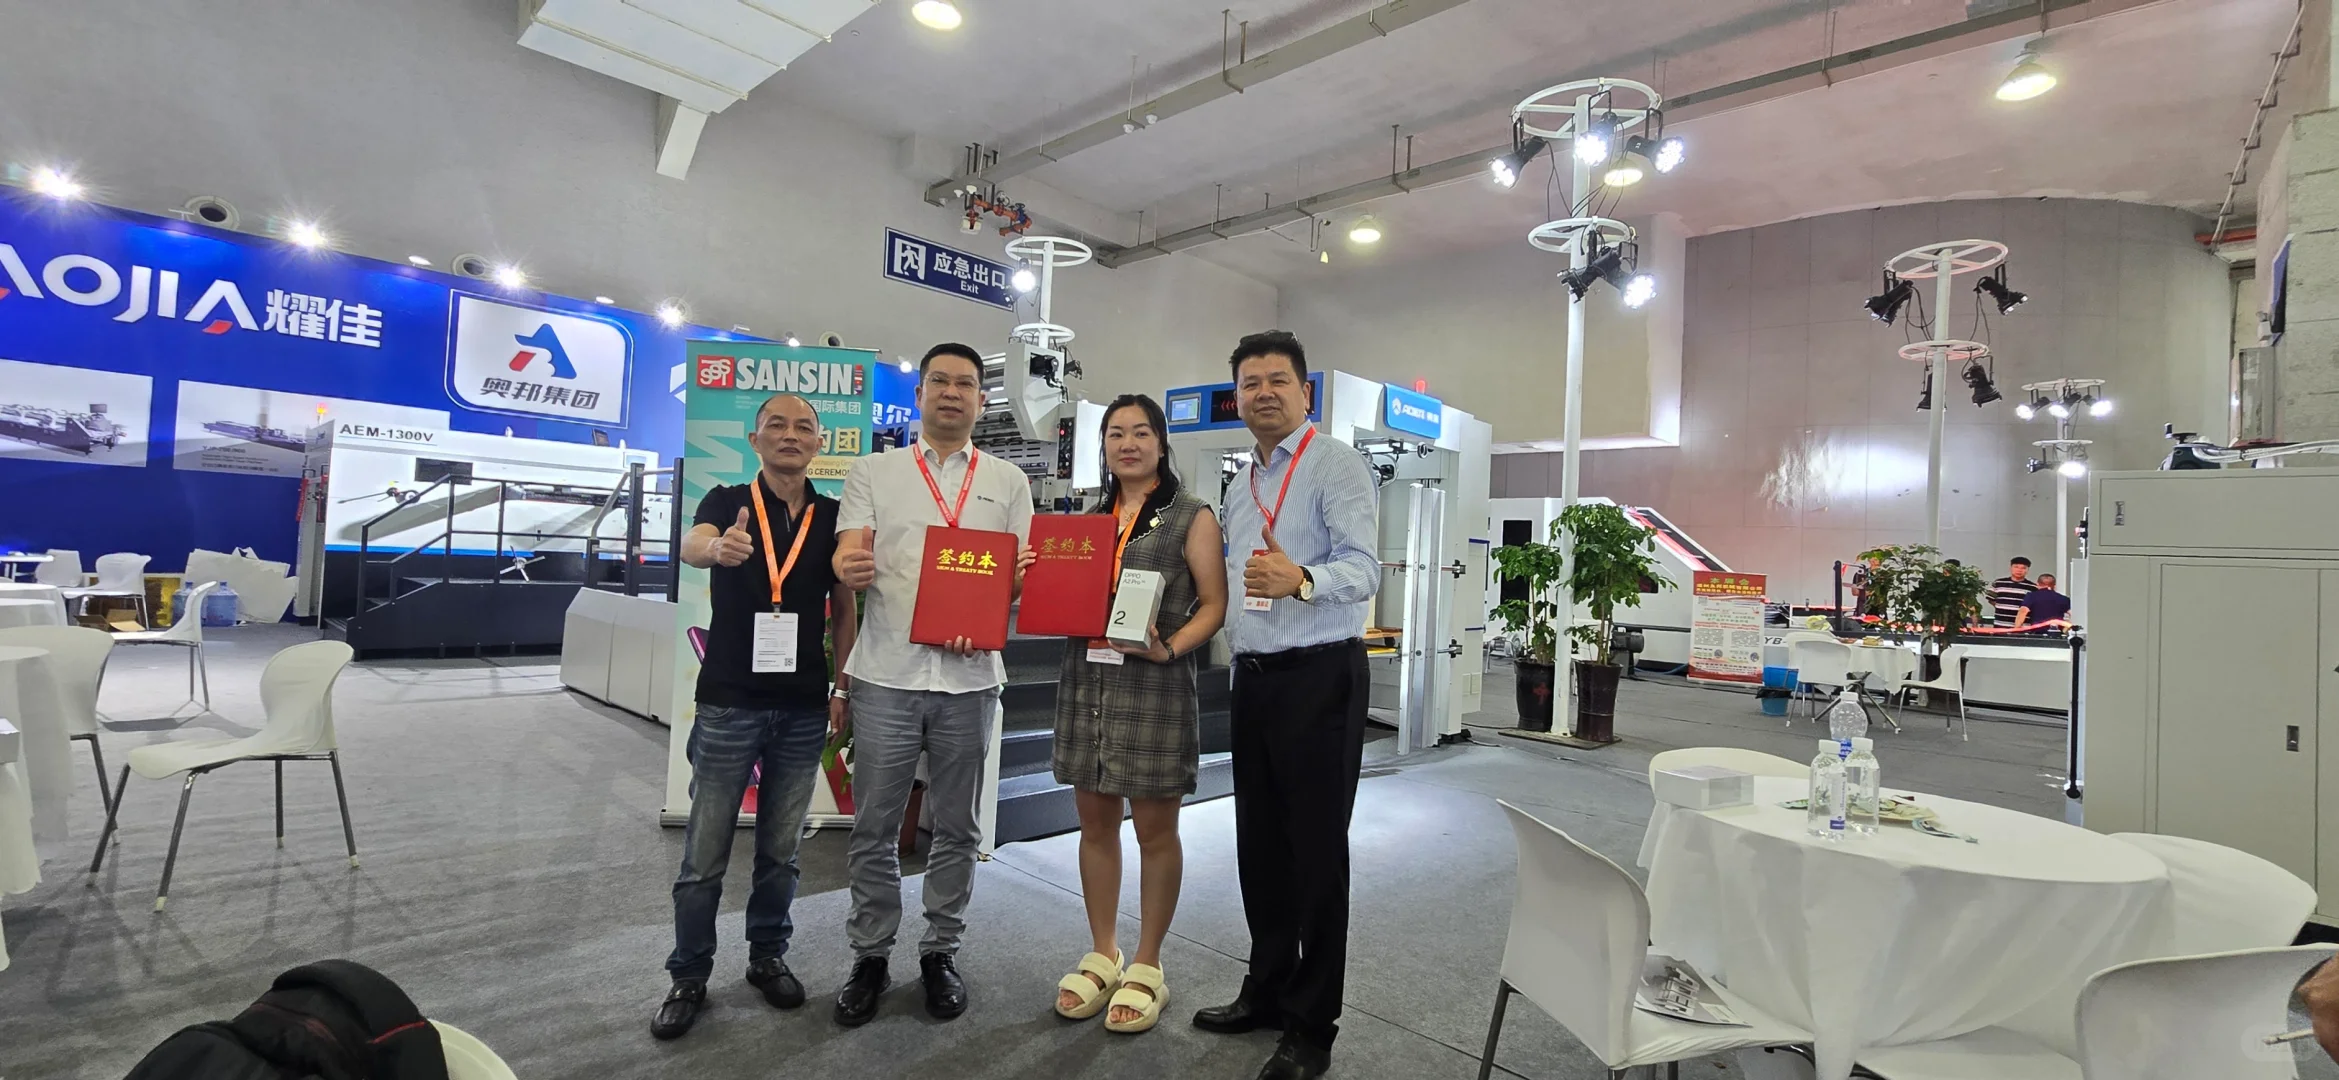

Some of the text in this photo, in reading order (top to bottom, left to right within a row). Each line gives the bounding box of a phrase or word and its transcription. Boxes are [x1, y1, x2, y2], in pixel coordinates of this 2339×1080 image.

[933, 252, 1006, 290] 应急出口
[960, 281, 980, 295] Exit
[264, 288, 383, 348] 耀佳
[736, 357, 853, 395] SANSIN
[480, 377, 600, 410] 奥邦集团
[339, 423, 434, 442] AEM-1300V
[1040, 536, 1096, 554] 签约本
[937, 548, 998, 569] 签约本
[1113, 610, 1126, 625] 2
